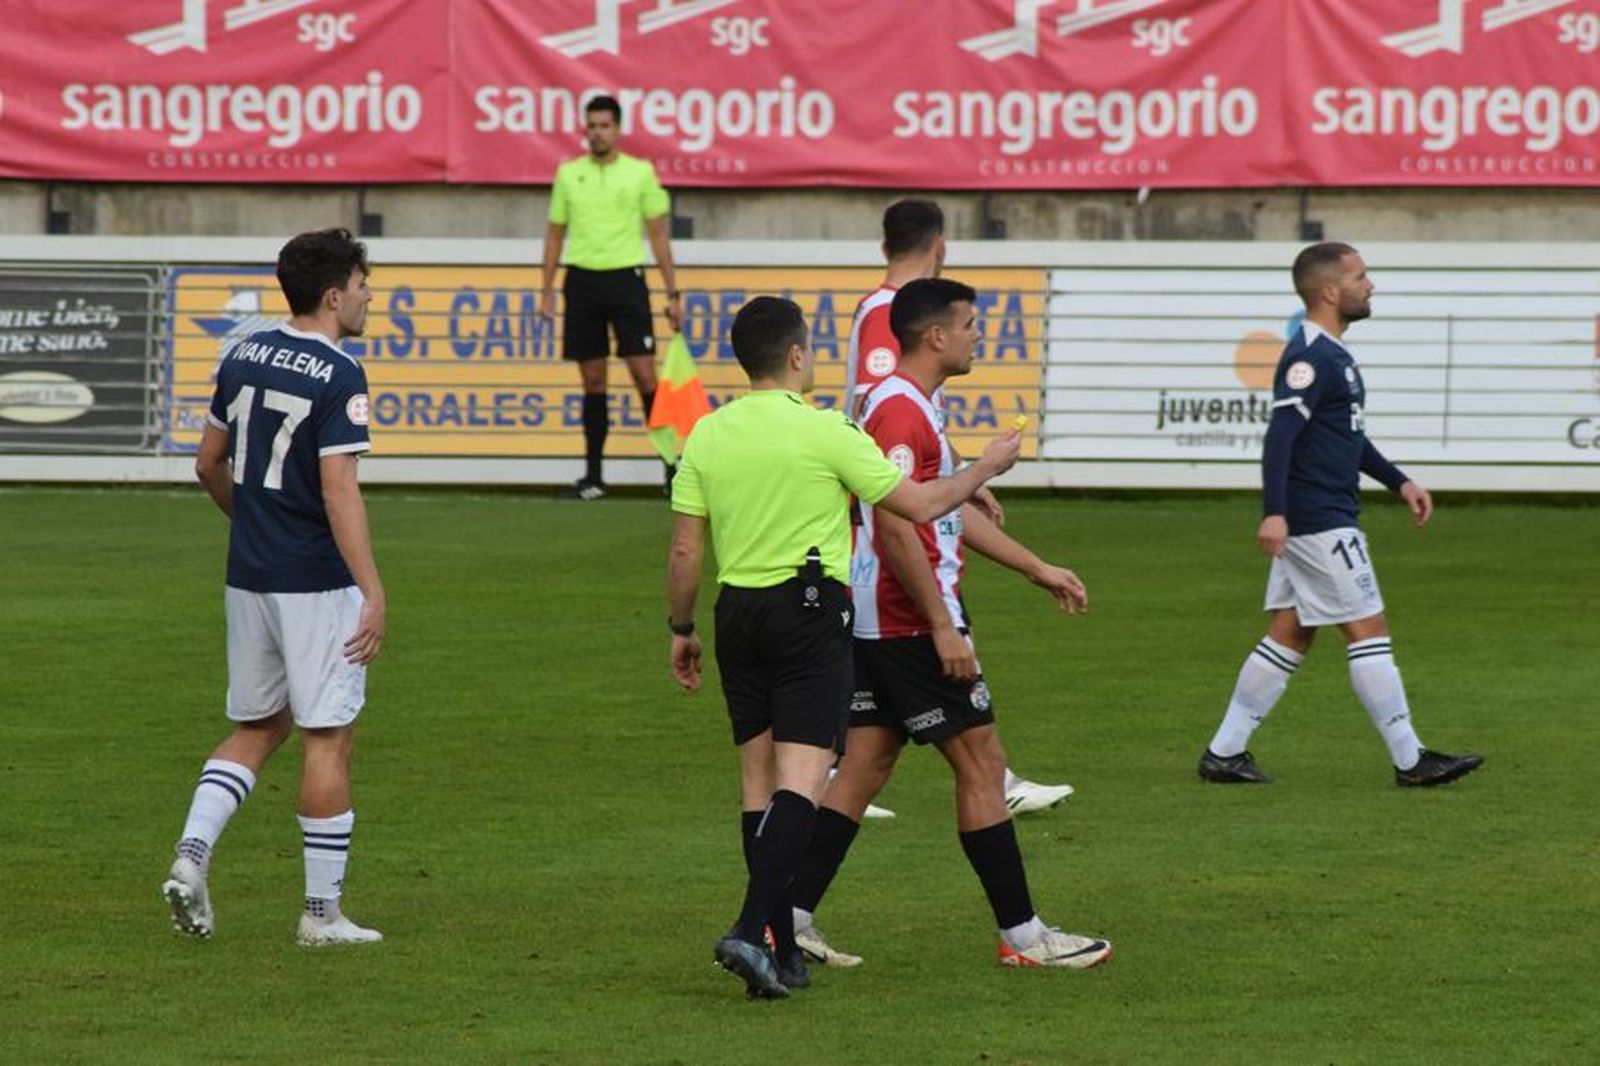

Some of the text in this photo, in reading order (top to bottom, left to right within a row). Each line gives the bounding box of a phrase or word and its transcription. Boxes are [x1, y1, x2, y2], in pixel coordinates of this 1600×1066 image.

[298, 12, 356, 51] sgc
[710, 17, 769, 55] sgc
[1131, 17, 1192, 56] sgc
[61, 70, 422, 148] sangregorio
[893, 74, 1258, 154] sangregorio
[148, 152, 337, 168] CONSTRUCCION
[978, 159, 1170, 175] CONSTRUCCION
[1400, 157, 1596, 173] CONSTRUCCION
[271, 348, 334, 384] ELENA
[374, 393, 545, 427] ORALES
[562, 394, 643, 427] DL
[1157, 389, 1270, 431] juventu
[226, 384, 313, 490] 17
[1332, 536, 1367, 570] 11
